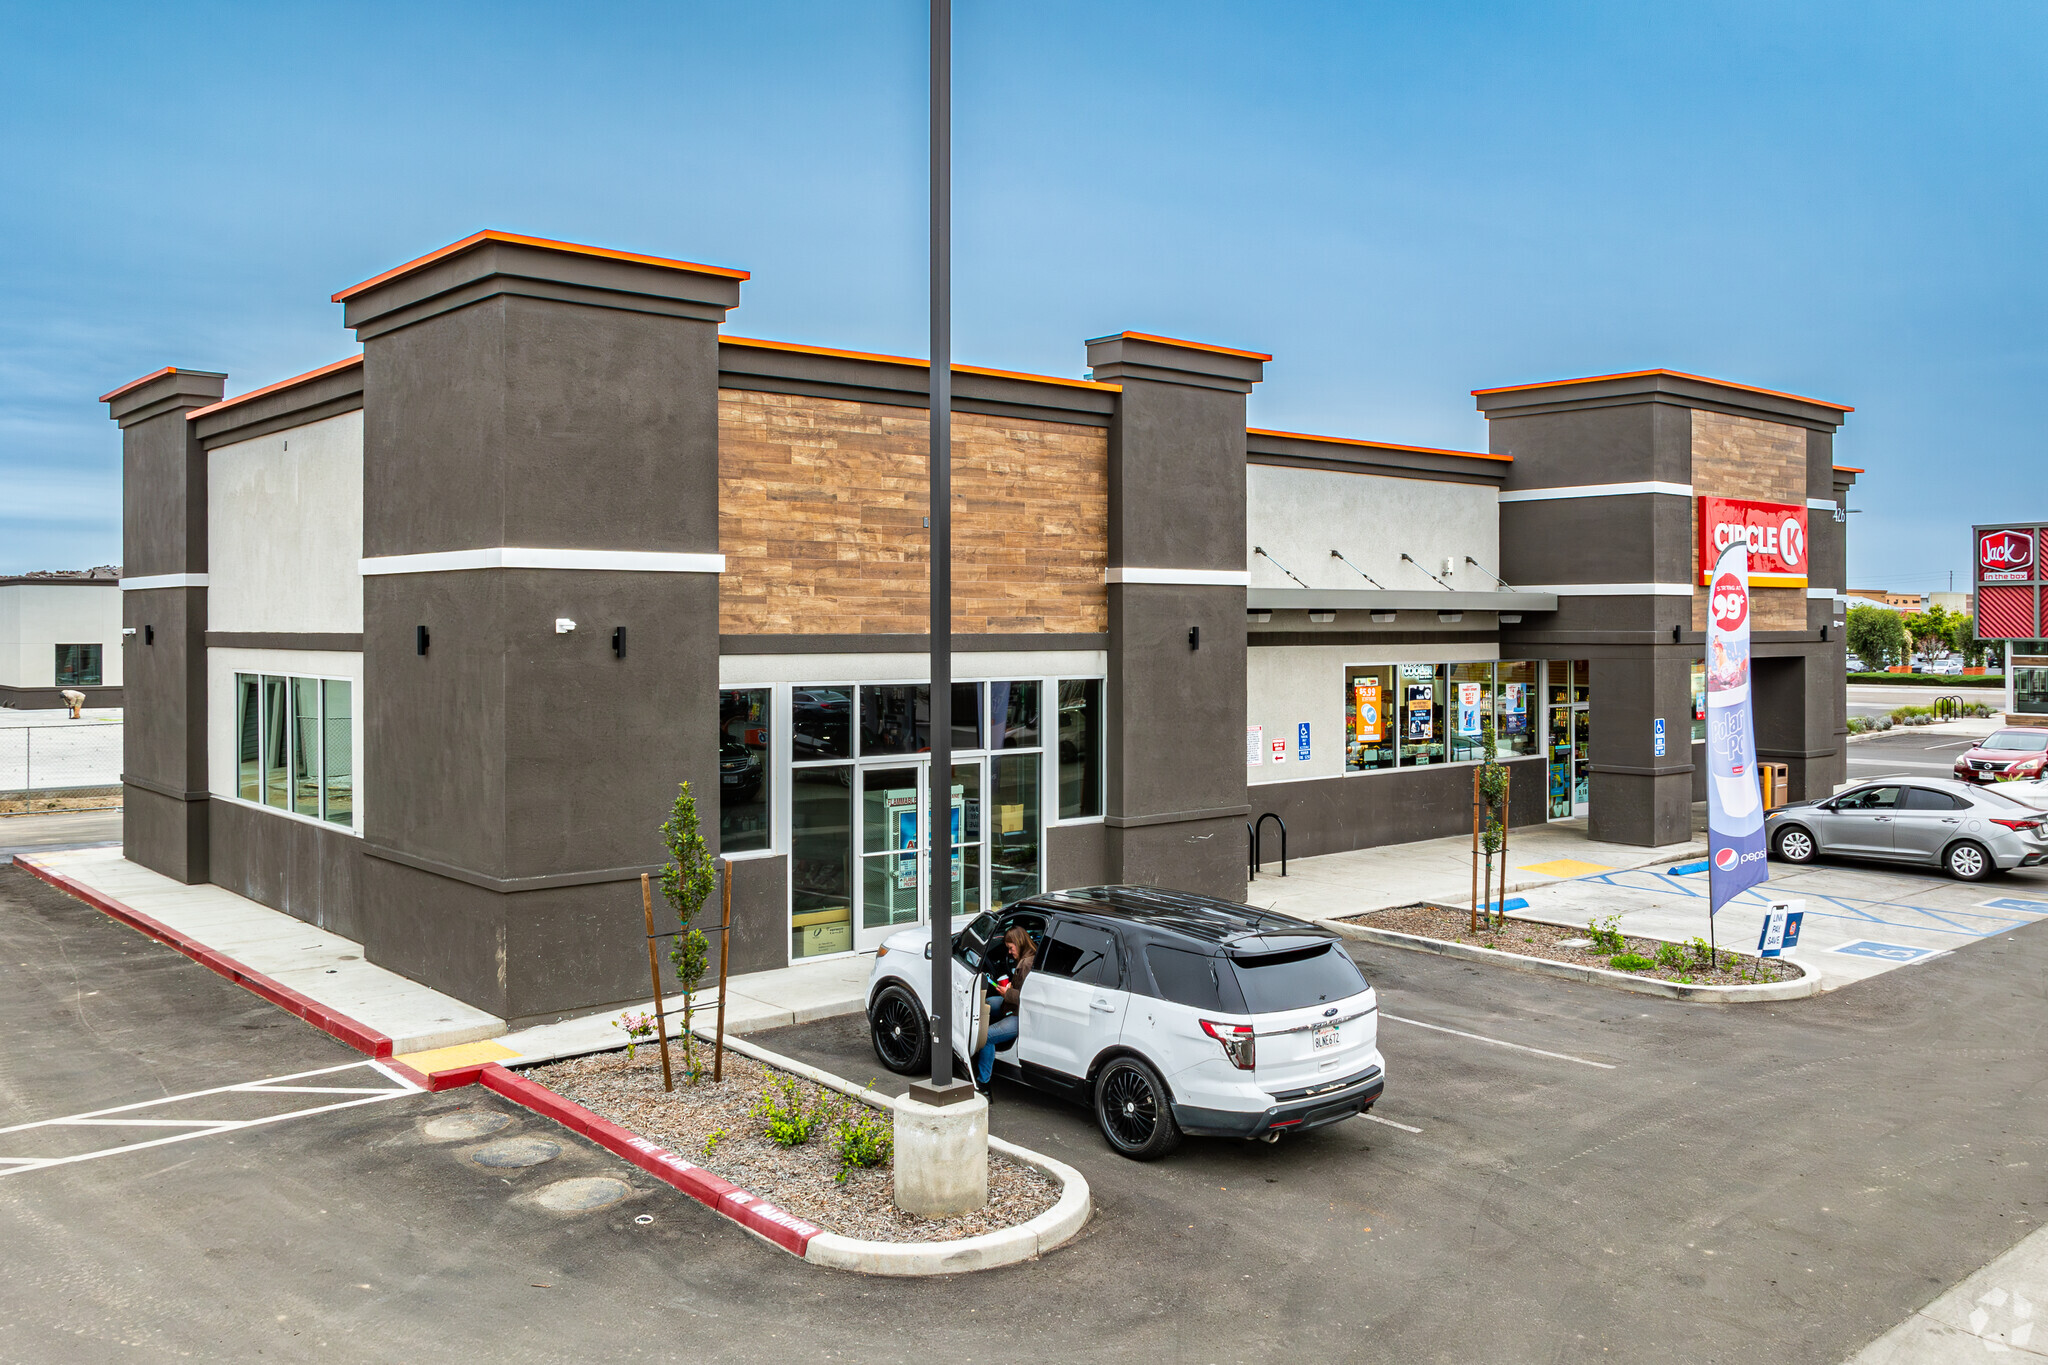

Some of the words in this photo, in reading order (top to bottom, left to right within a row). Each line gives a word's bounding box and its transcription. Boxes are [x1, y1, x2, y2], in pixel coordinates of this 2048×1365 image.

[1832, 507, 1845, 522] 426
[1714, 522, 1778, 554] CIRCLE
[1783, 522, 1803, 563] K
[1983, 536, 2027, 563] Jack
[1994, 572, 2009, 580] the
[2010, 571, 2026, 580] box
[1359, 687, 1376, 697] $5.99
[1712, 709, 1744, 743] Polar
[1740, 847, 1767, 865] pepsi
[1773, 913, 1784, 923] LINK
[1767, 936, 1781, 945] SAVE
[626, 1137, 662, 1153] FIRE
[658, 1153, 698, 1171] LANE
[726, 1191, 754, 1204] NO
[751, 1204, 817, 1236] PARKING
